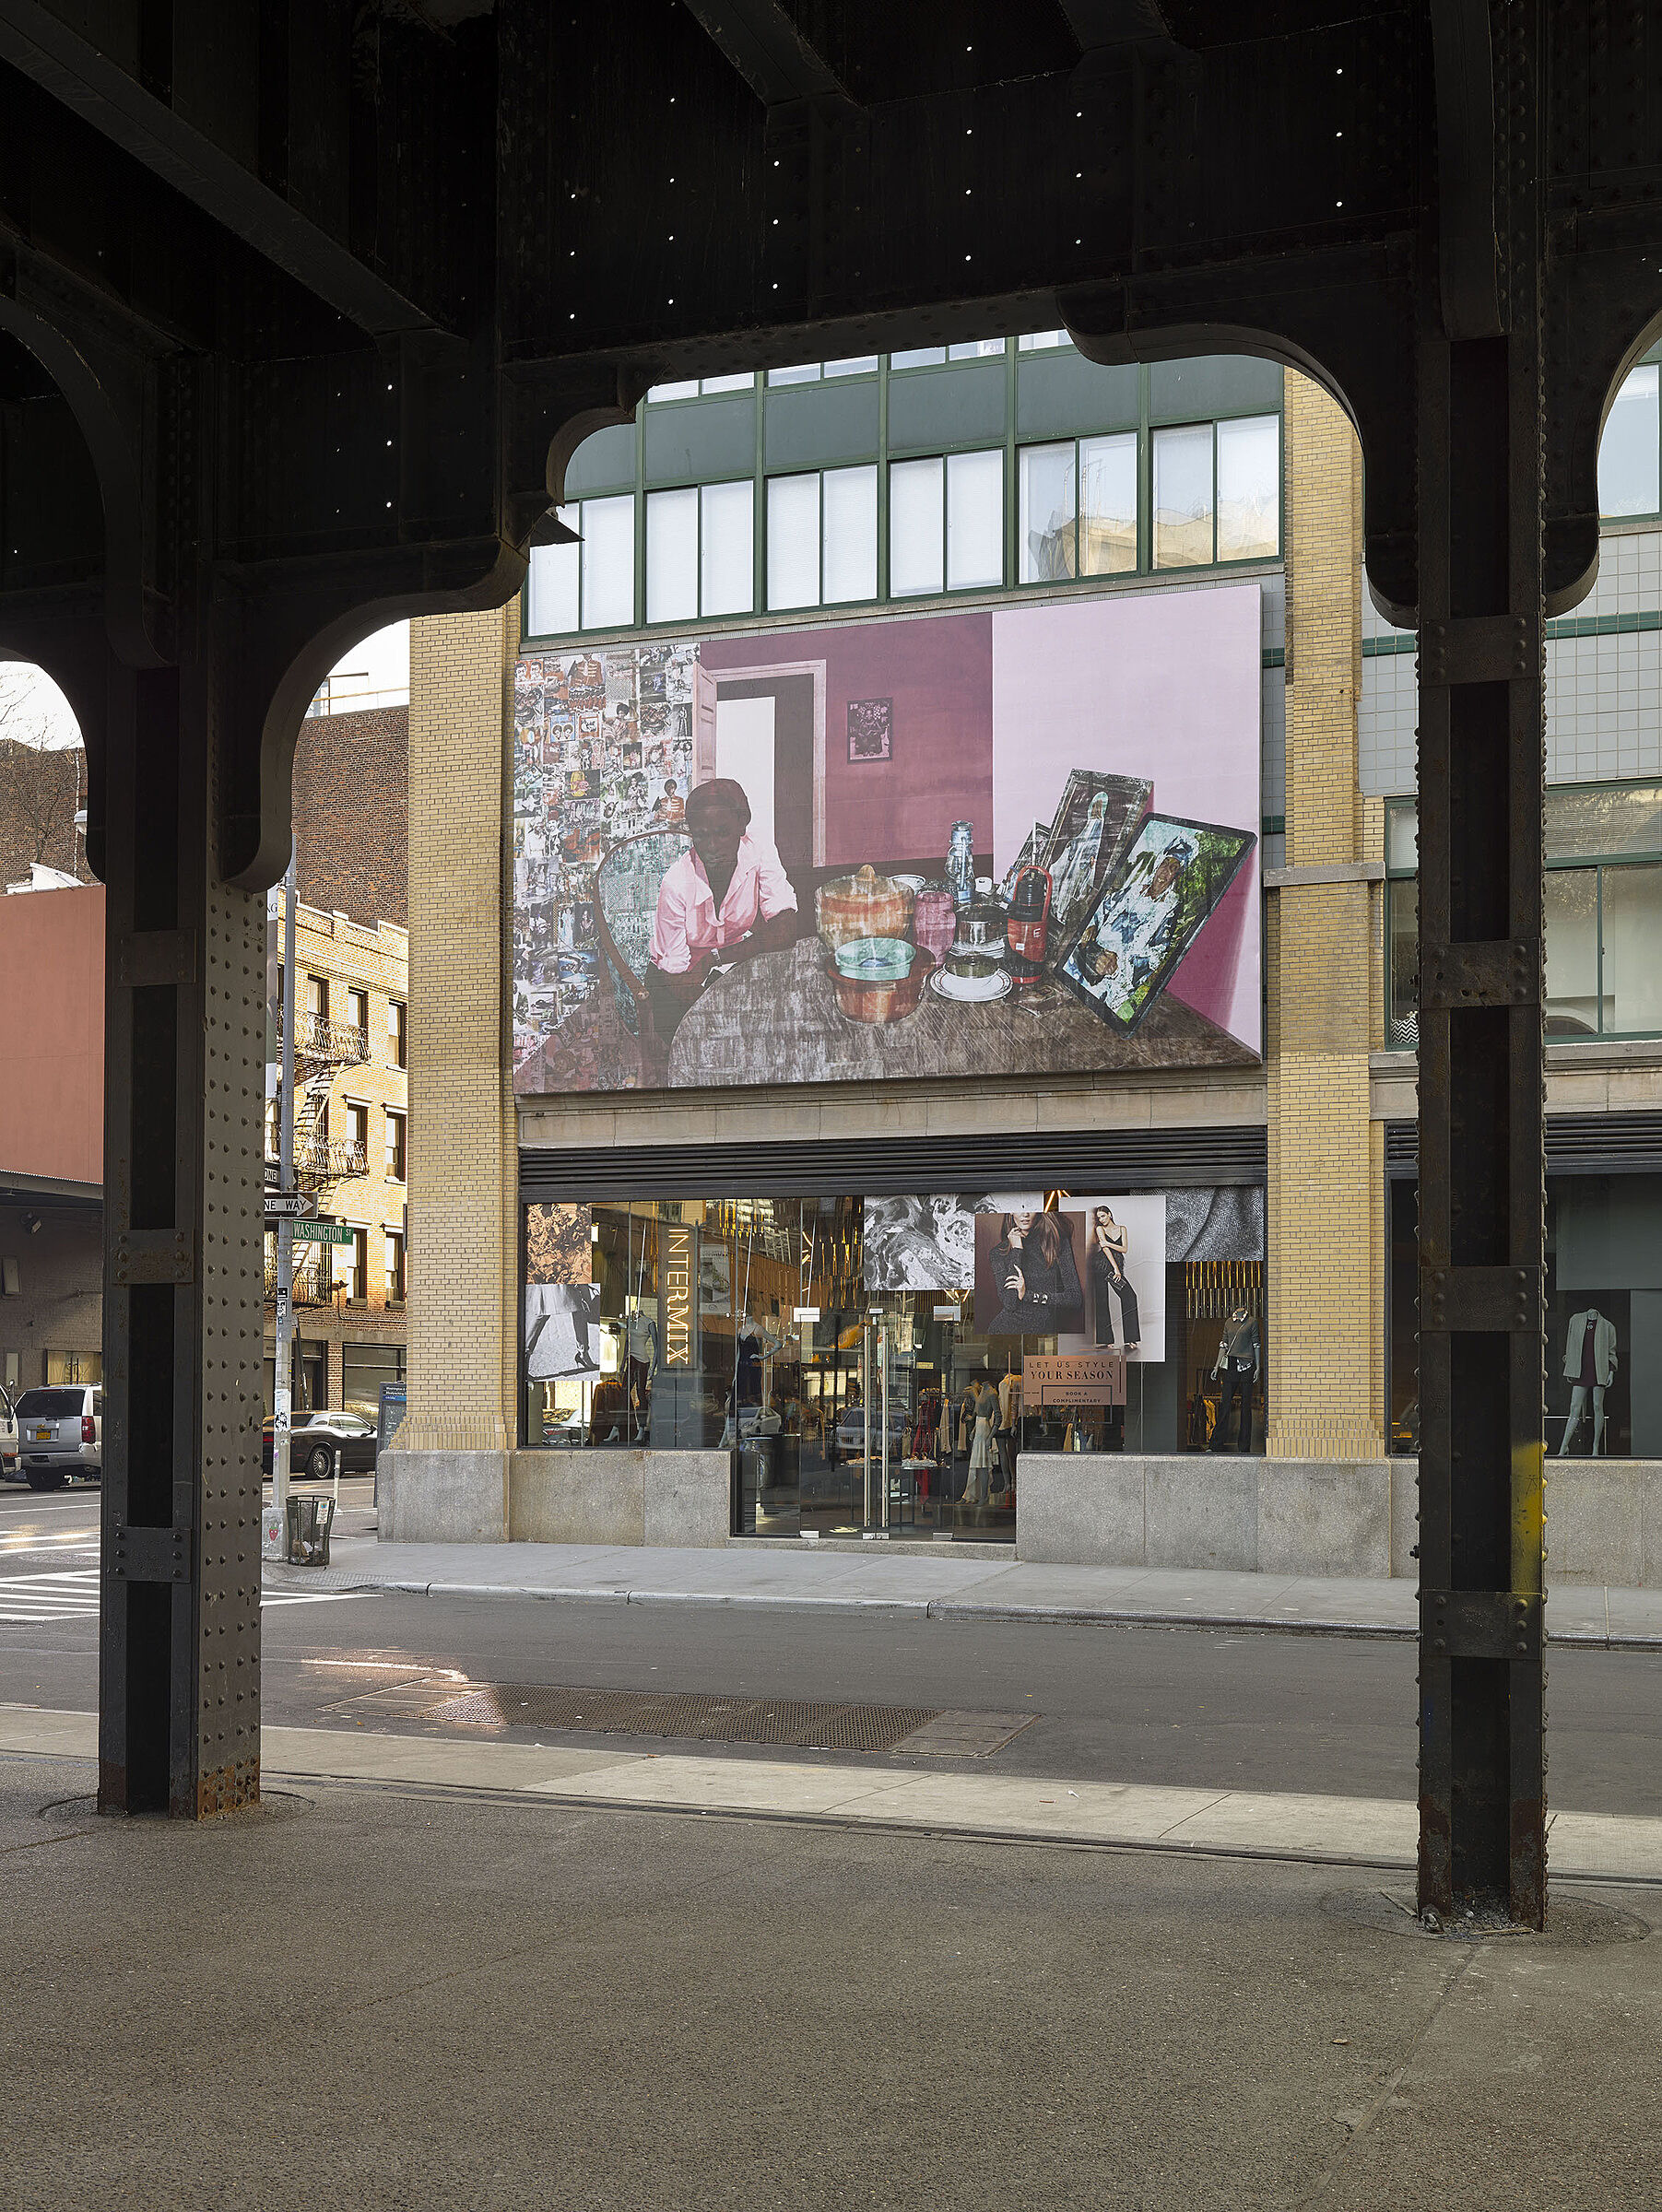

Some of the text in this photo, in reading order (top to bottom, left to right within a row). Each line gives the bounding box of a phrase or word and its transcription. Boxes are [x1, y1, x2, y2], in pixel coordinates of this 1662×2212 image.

[265, 1200, 306, 1210] NE WAY
[293, 1223, 351, 1242] WASHINGTON ST
[667, 1229, 689, 1365] INTERMIX
[1031, 1371, 1114, 1380] YOUR SEASON
